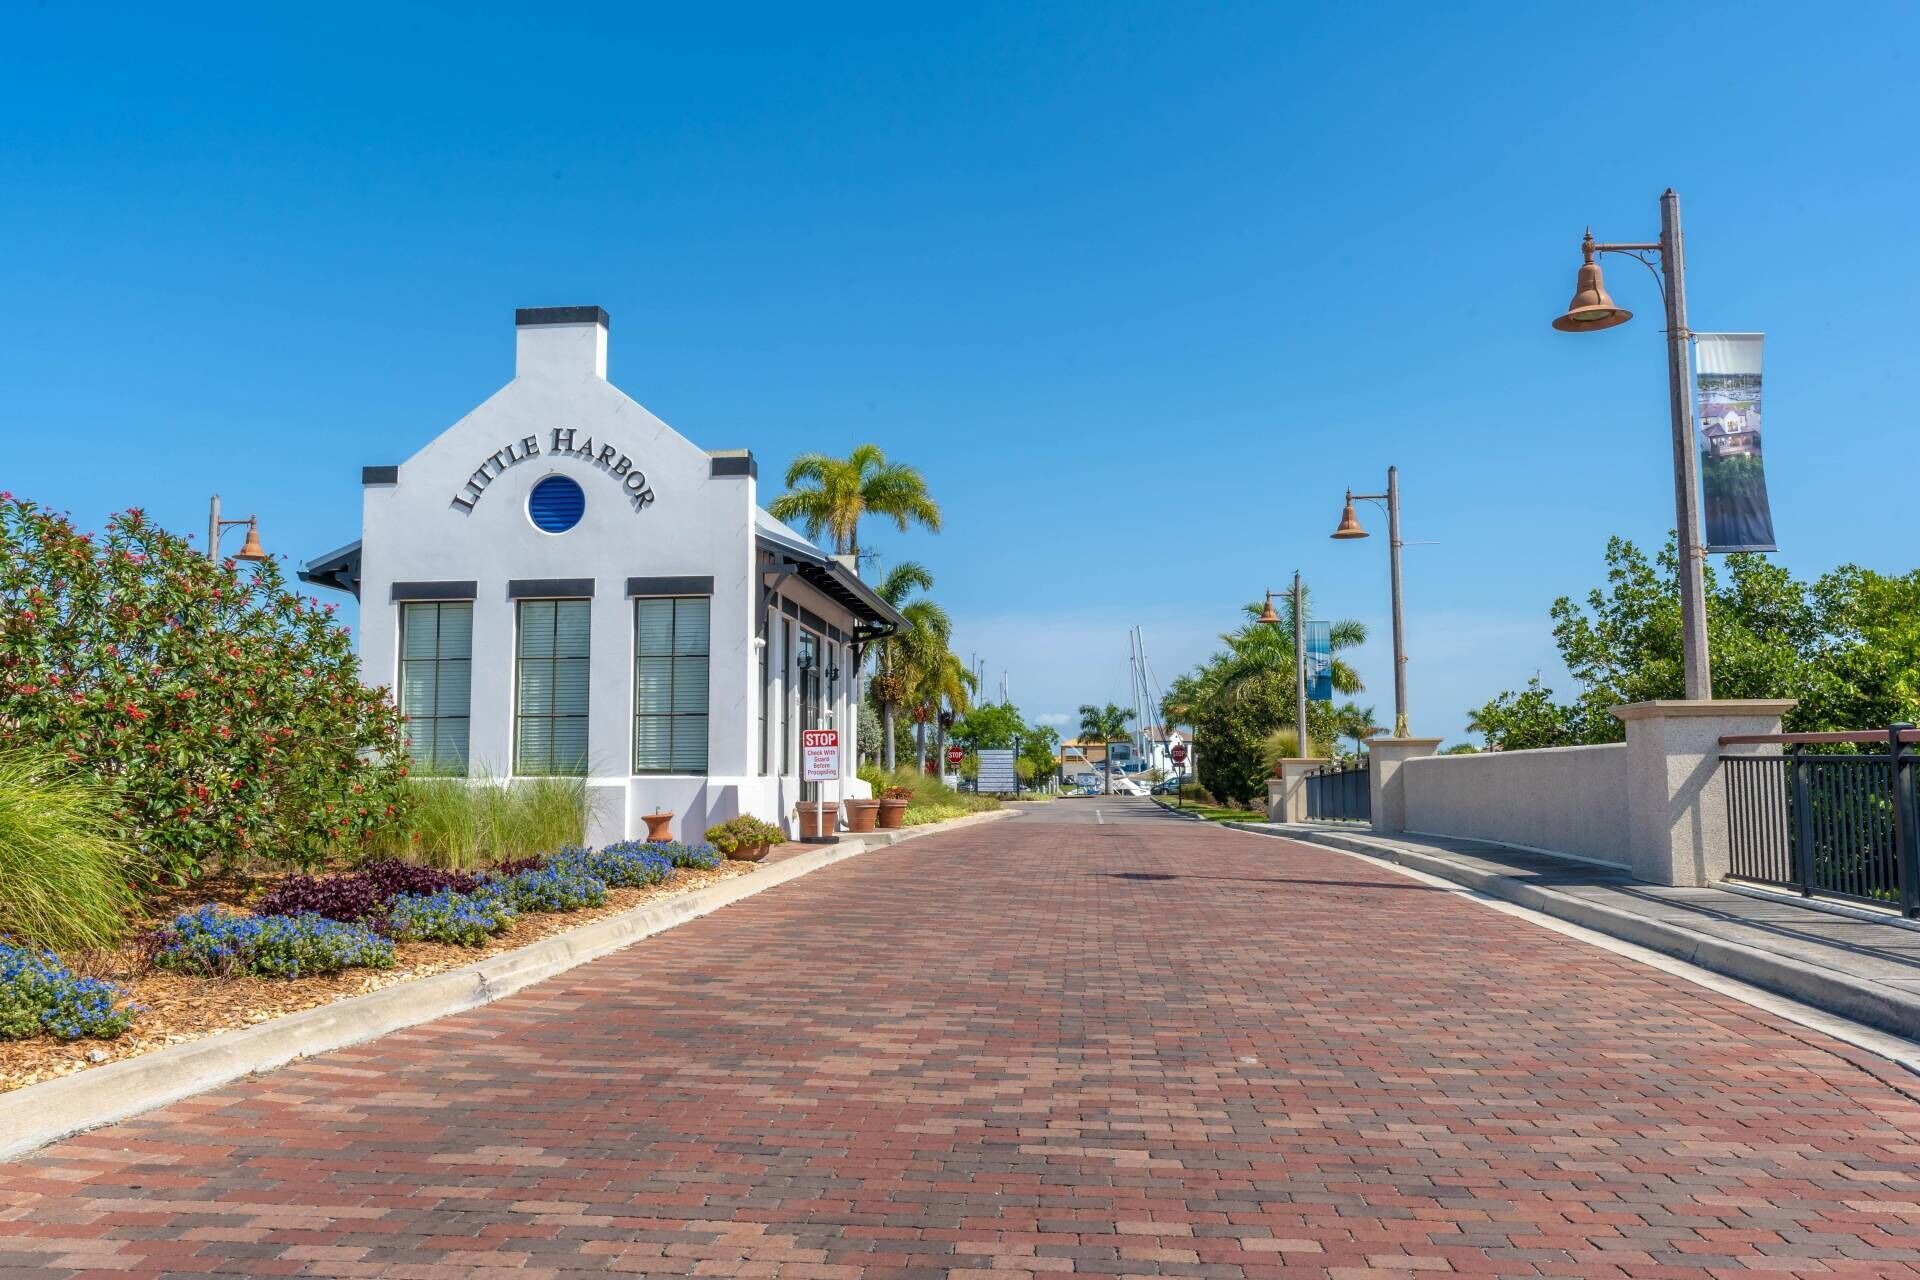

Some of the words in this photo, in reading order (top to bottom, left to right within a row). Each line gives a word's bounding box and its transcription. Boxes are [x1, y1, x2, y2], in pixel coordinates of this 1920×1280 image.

[451, 434, 540, 512] LITTLE
[551, 428, 655, 509] HARBOR
[806, 733, 836, 746] STOP
